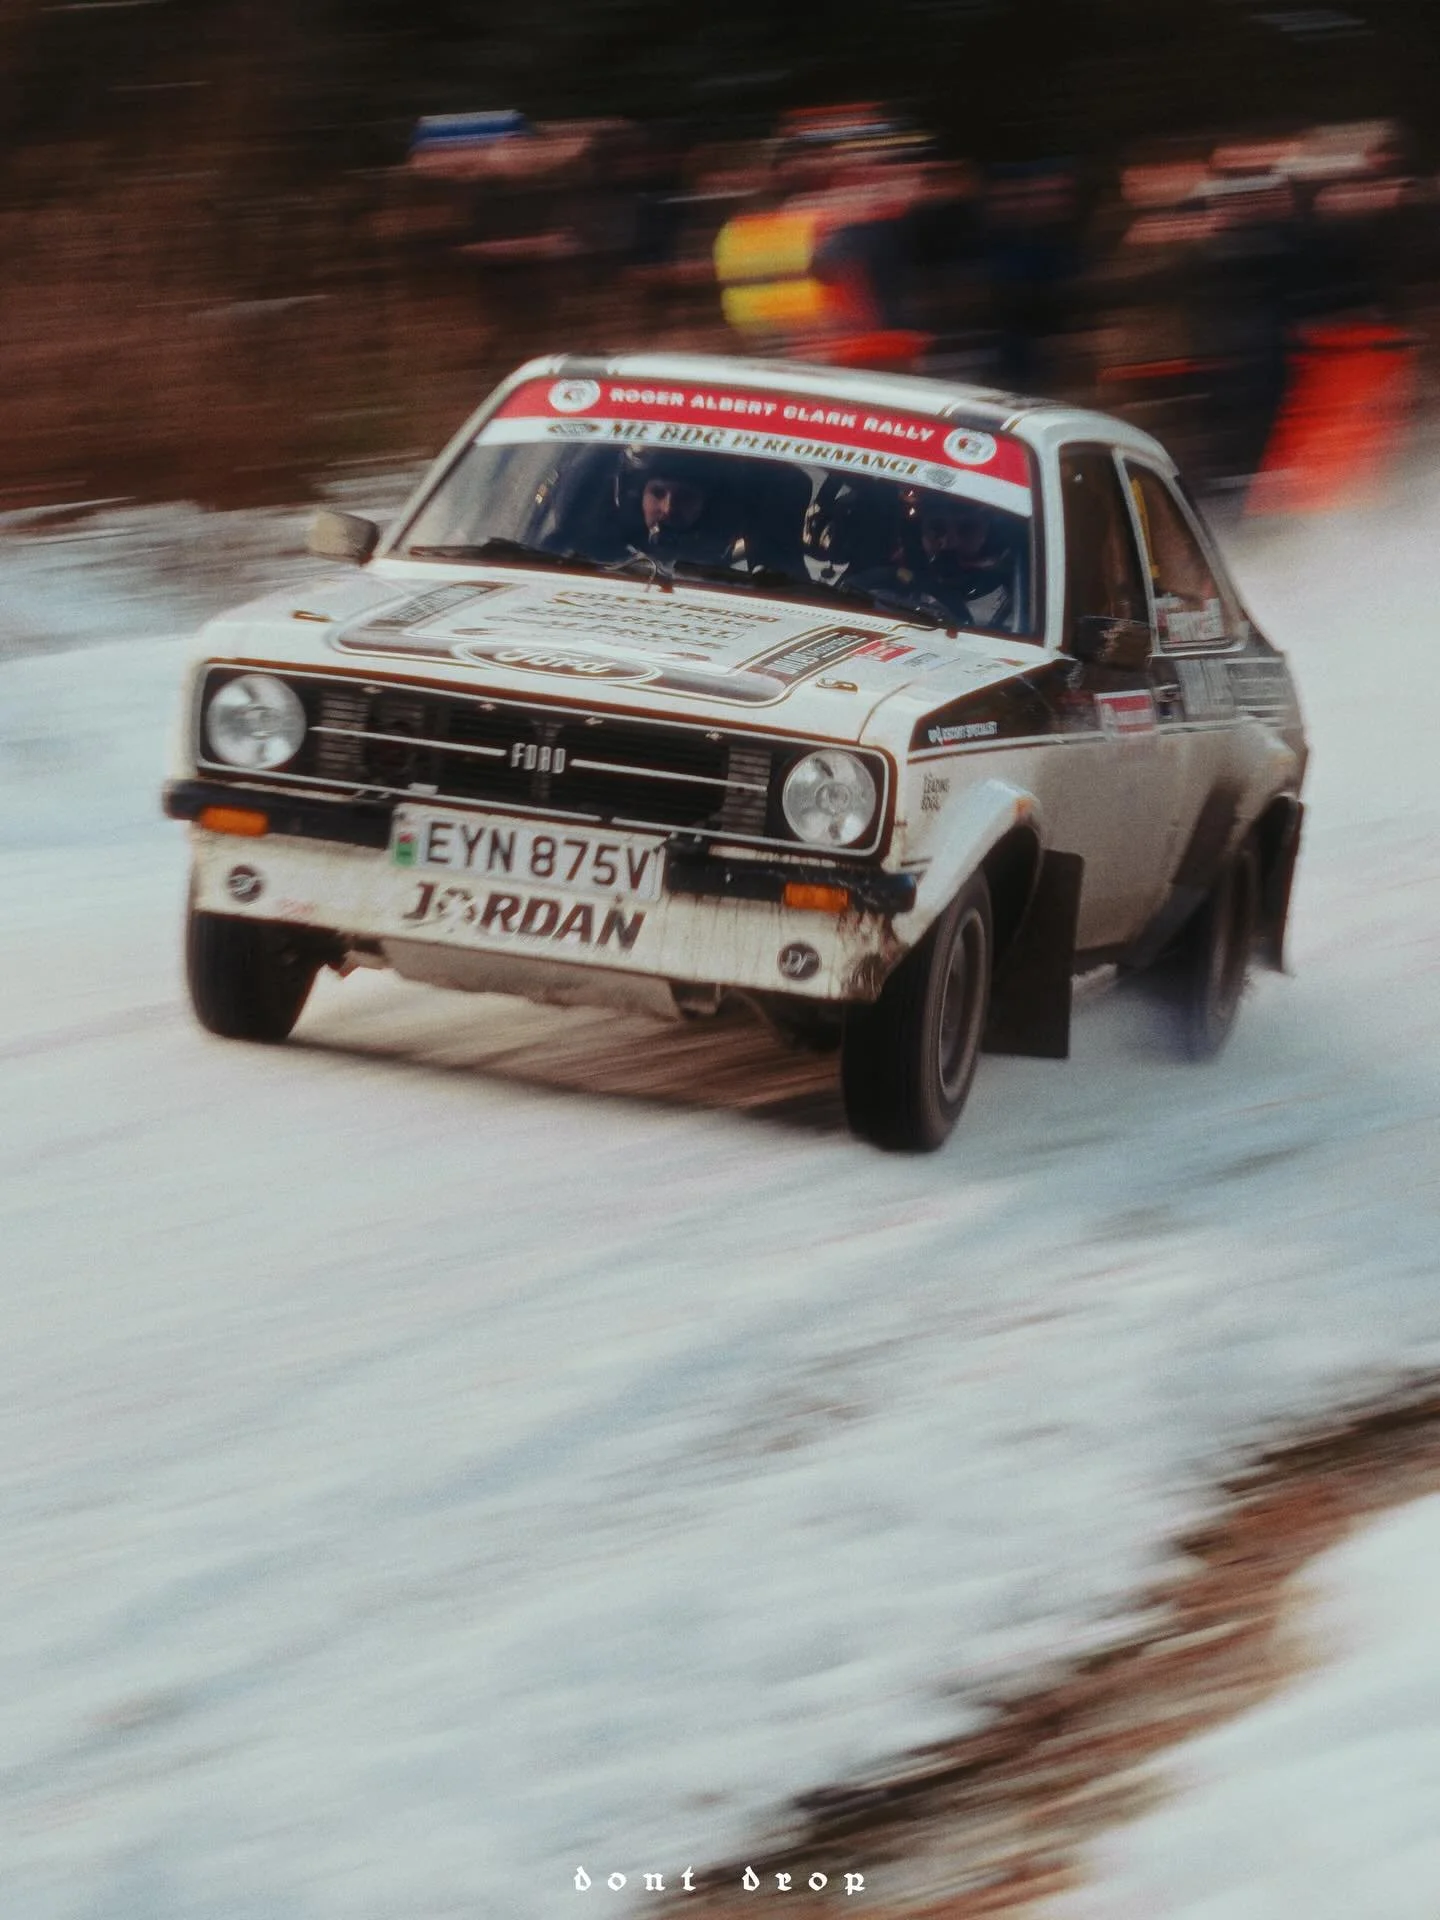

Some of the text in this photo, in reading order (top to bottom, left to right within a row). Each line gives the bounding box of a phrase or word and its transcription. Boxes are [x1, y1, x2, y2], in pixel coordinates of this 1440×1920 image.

[609, 387, 935, 442] ROGER ALBERT CLARK RALLY
[494, 648, 618, 674] Ford
[510, 742, 566, 774] FORD
[426, 820, 650, 890] EYN 875V
